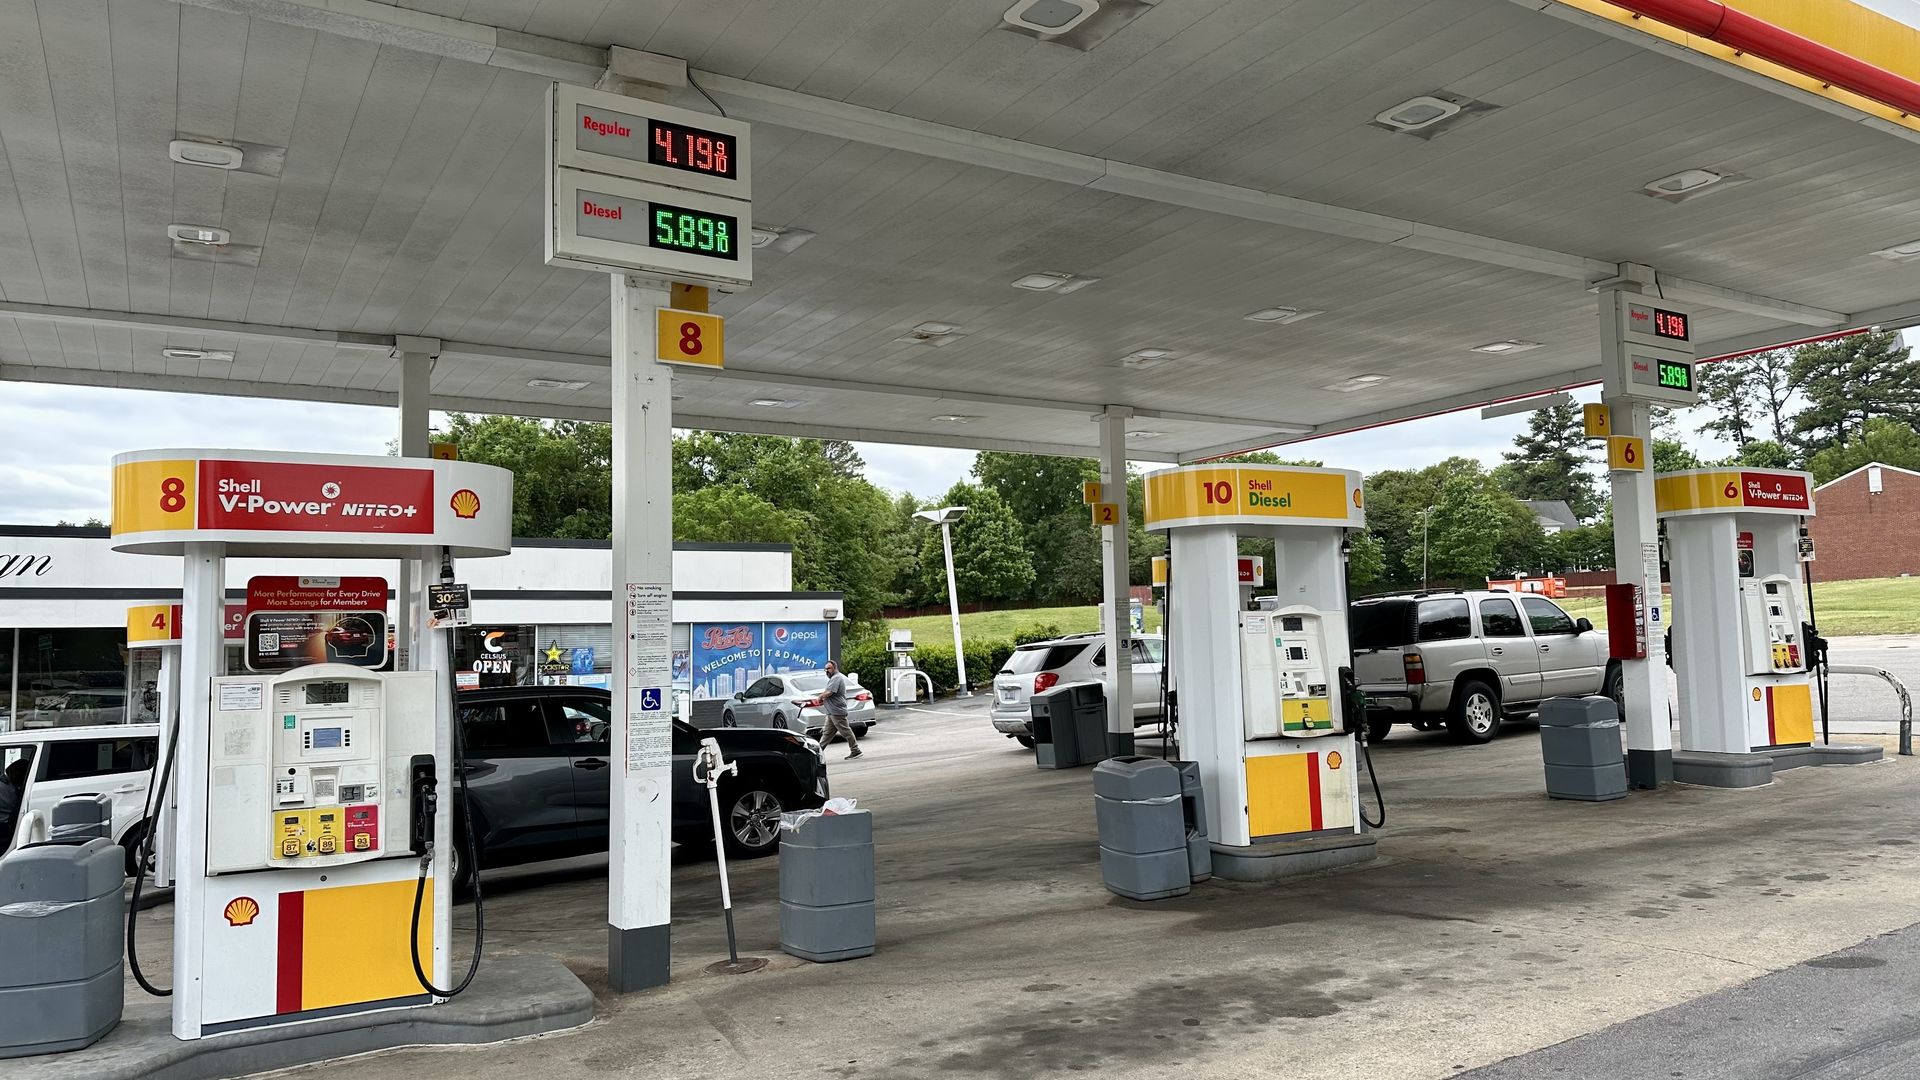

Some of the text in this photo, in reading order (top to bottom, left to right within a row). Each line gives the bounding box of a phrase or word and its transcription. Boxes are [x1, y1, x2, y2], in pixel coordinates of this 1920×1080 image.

[583, 116, 631, 138] Regular
[655, 127, 713, 170] 4.19
[583, 201, 622, 220] Diesel
[656, 210, 714, 250] 5.89
[1631, 309, 1649, 321] Regular
[679, 321, 703, 356] 8
[1633, 361, 1649, 372] Diesel
[1599, 414, 1605, 426] 5
[1624, 442, 1636, 464] 6
[218, 479, 261, 493] Shell
[1203, 480, 1233, 504] 10
[1248, 479, 1272, 491] Shell
[1724, 481, 1738, 499] 6
[1748, 481, 1760, 489] Shell
[160, 477, 186, 513] 8
[1092, 488, 1096, 497] 1
[1249, 491, 1292, 508] Diesel
[1748, 489, 1781, 500] V-Power
[218, 494, 332, 516] V-Power
[1102, 507, 1112, 521] 2
[254, 590, 380, 599] More Performance for Every Drive
[267, 598, 368, 607] More Savings for Members
[151, 613, 166, 630] 4
[791, 630, 818, 641] pepsi
[472, 660, 512, 674] OPEN
[701, 649, 818, 674] WELCOME TO T & D MART
[286, 843, 297, 851] 87
[322, 840, 333, 848] 89
[357, 837, 368, 845] 93
